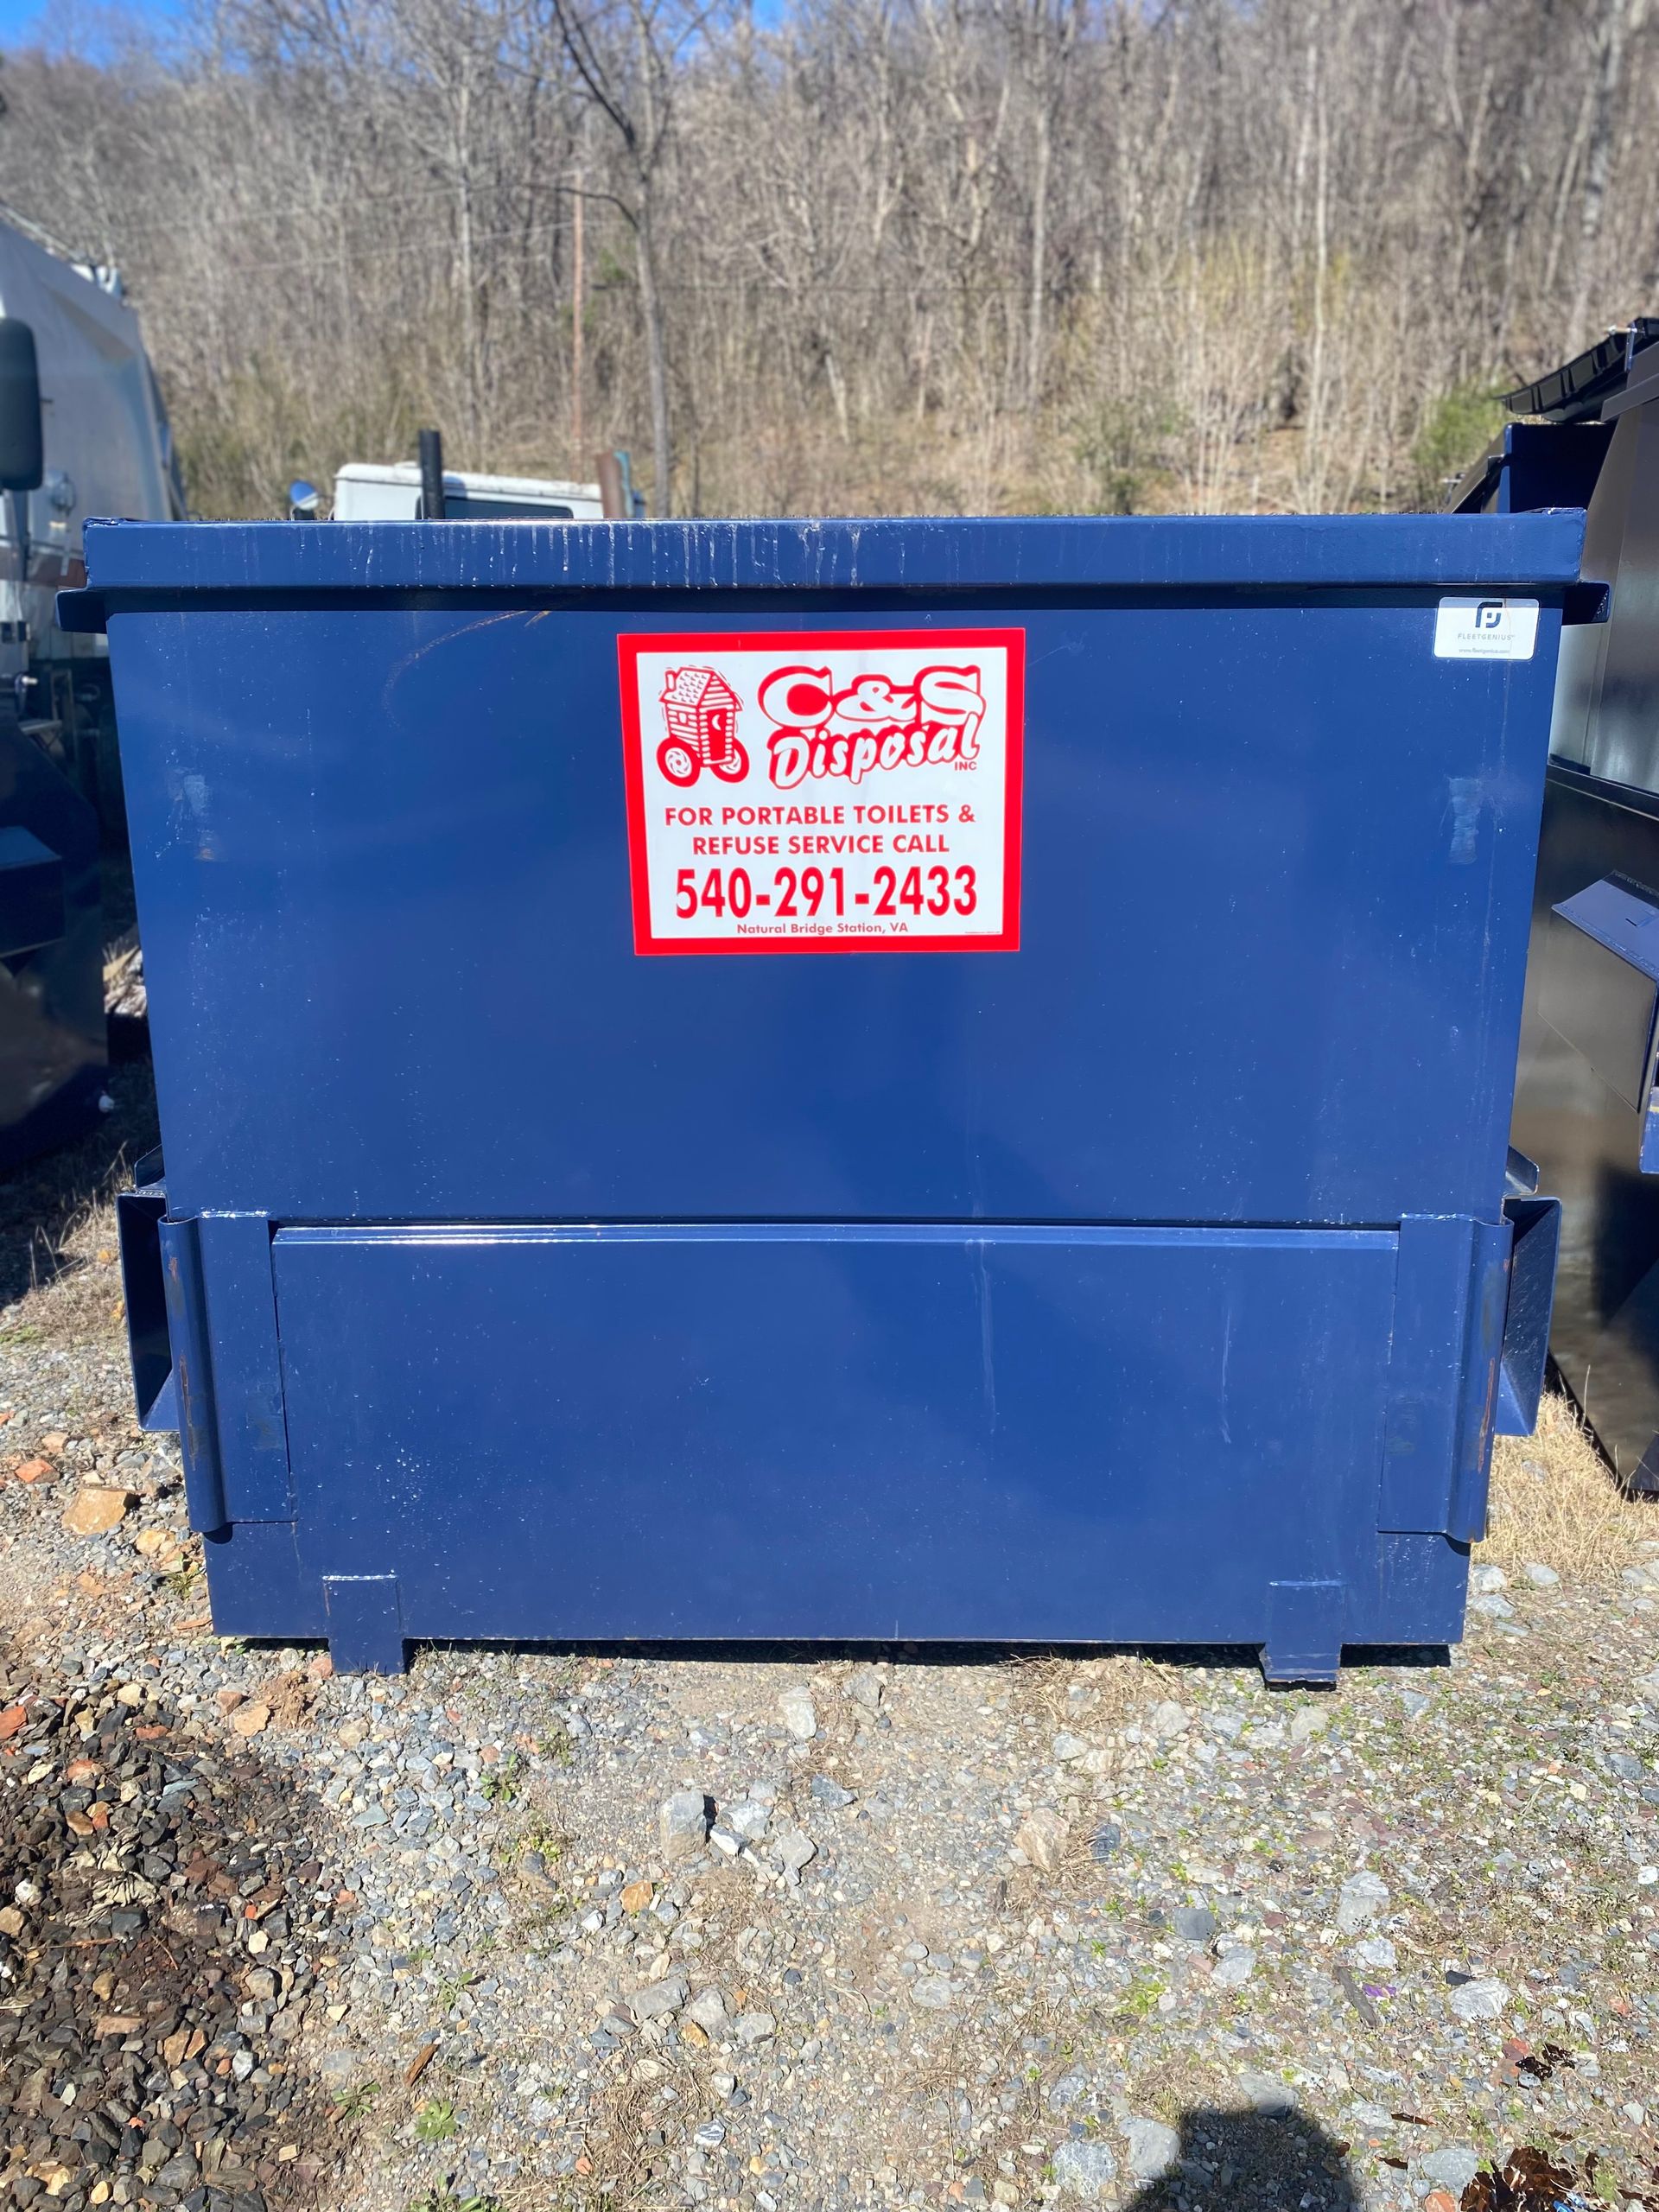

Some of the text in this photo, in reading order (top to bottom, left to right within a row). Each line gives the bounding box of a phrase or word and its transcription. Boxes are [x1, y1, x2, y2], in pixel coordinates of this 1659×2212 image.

[758, 664, 986, 728] C&S
[767, 712, 980, 790] Disposal
[954, 761, 977, 772] INC
[665, 804, 976, 826] FOR PORTABLE TOILETS &
[693, 835, 950, 855] REFUSE SERVICE CALL
[676, 864, 978, 919] 540-291-2433
[736, 922, 909, 936] Natural Bridge Station, VA
